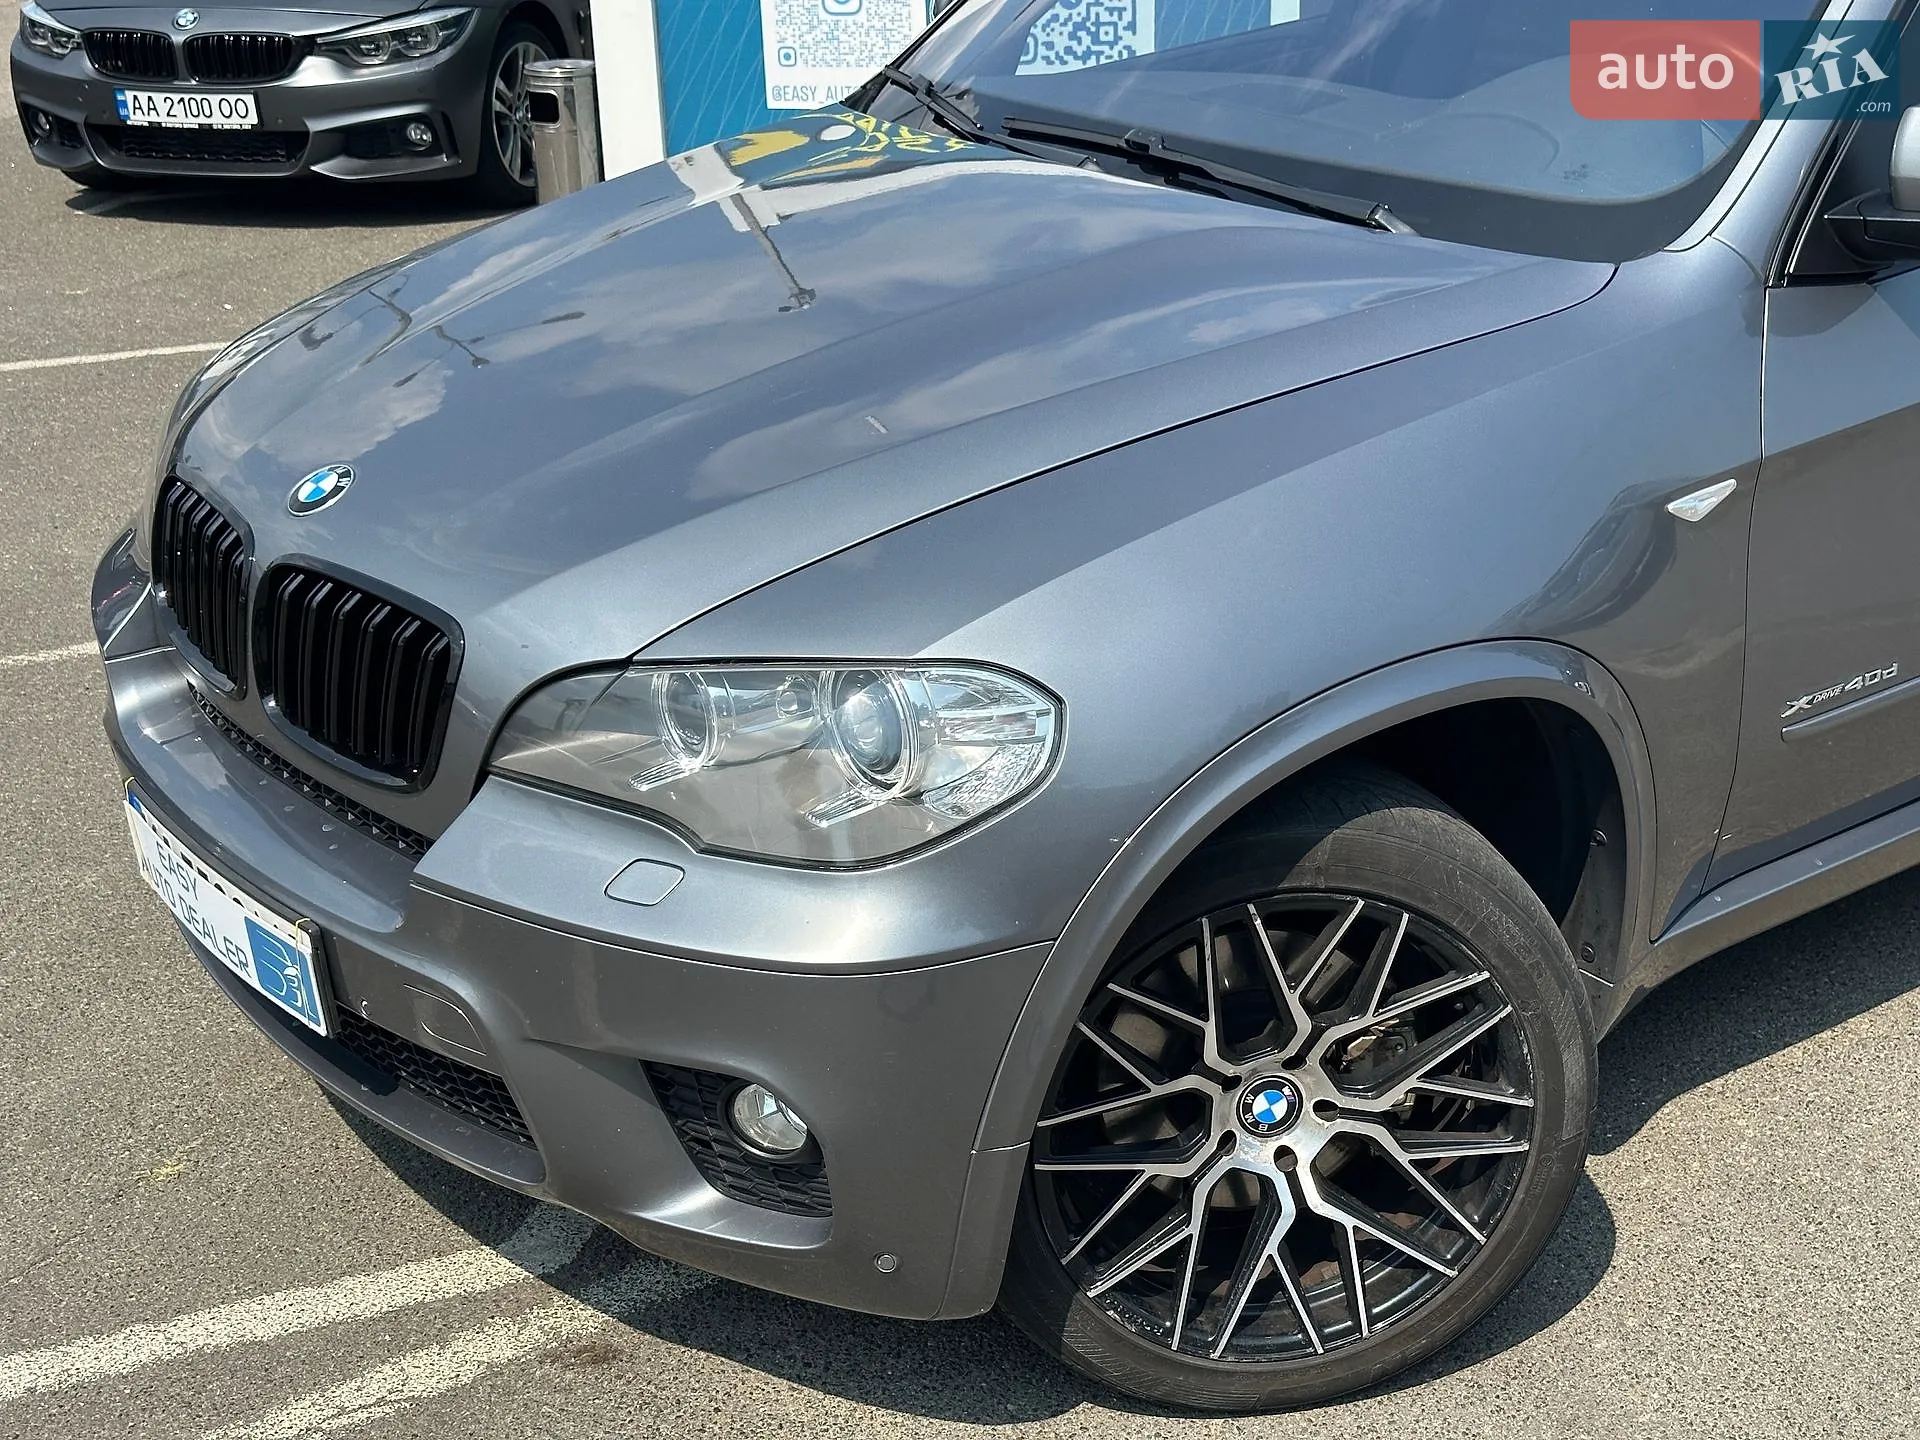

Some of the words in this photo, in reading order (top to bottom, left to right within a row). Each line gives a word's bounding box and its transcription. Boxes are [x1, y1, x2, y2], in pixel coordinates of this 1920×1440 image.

[133, 95, 160, 117] AA
[163, 96, 213, 118] 2100
[156, 841, 198, 901] EASY
[141, 857, 176, 908] AUTO
[178, 893, 252, 979] DEALER
